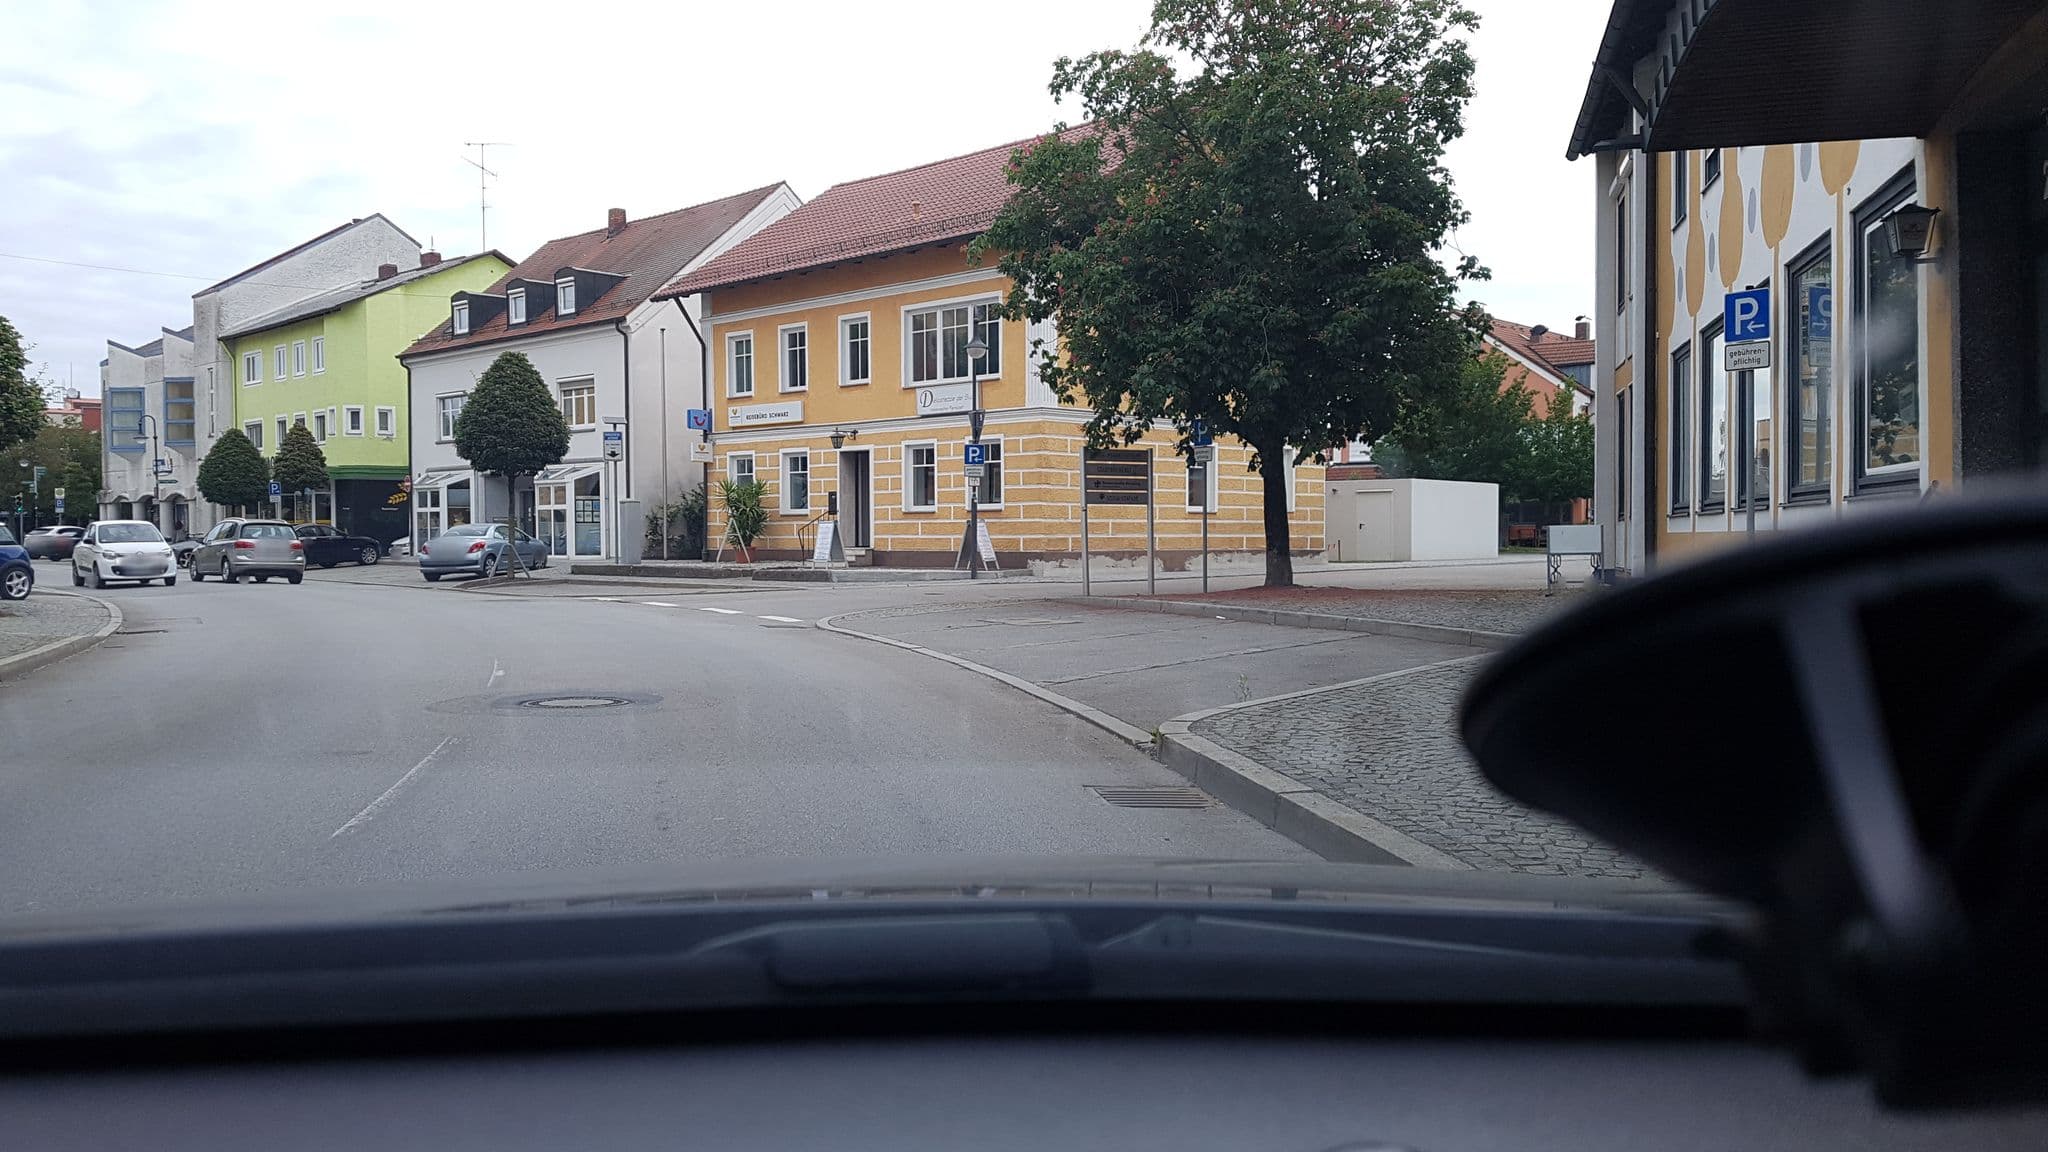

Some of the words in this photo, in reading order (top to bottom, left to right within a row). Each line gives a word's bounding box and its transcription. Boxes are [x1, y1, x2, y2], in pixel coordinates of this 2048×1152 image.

[1735, 297, 1758, 335] P
[1729, 347, 1766, 358] gebühren-
[1733, 355, 1761, 366] pflichtig
[968, 446, 980, 463] P
[271, 483, 279, 494] P
